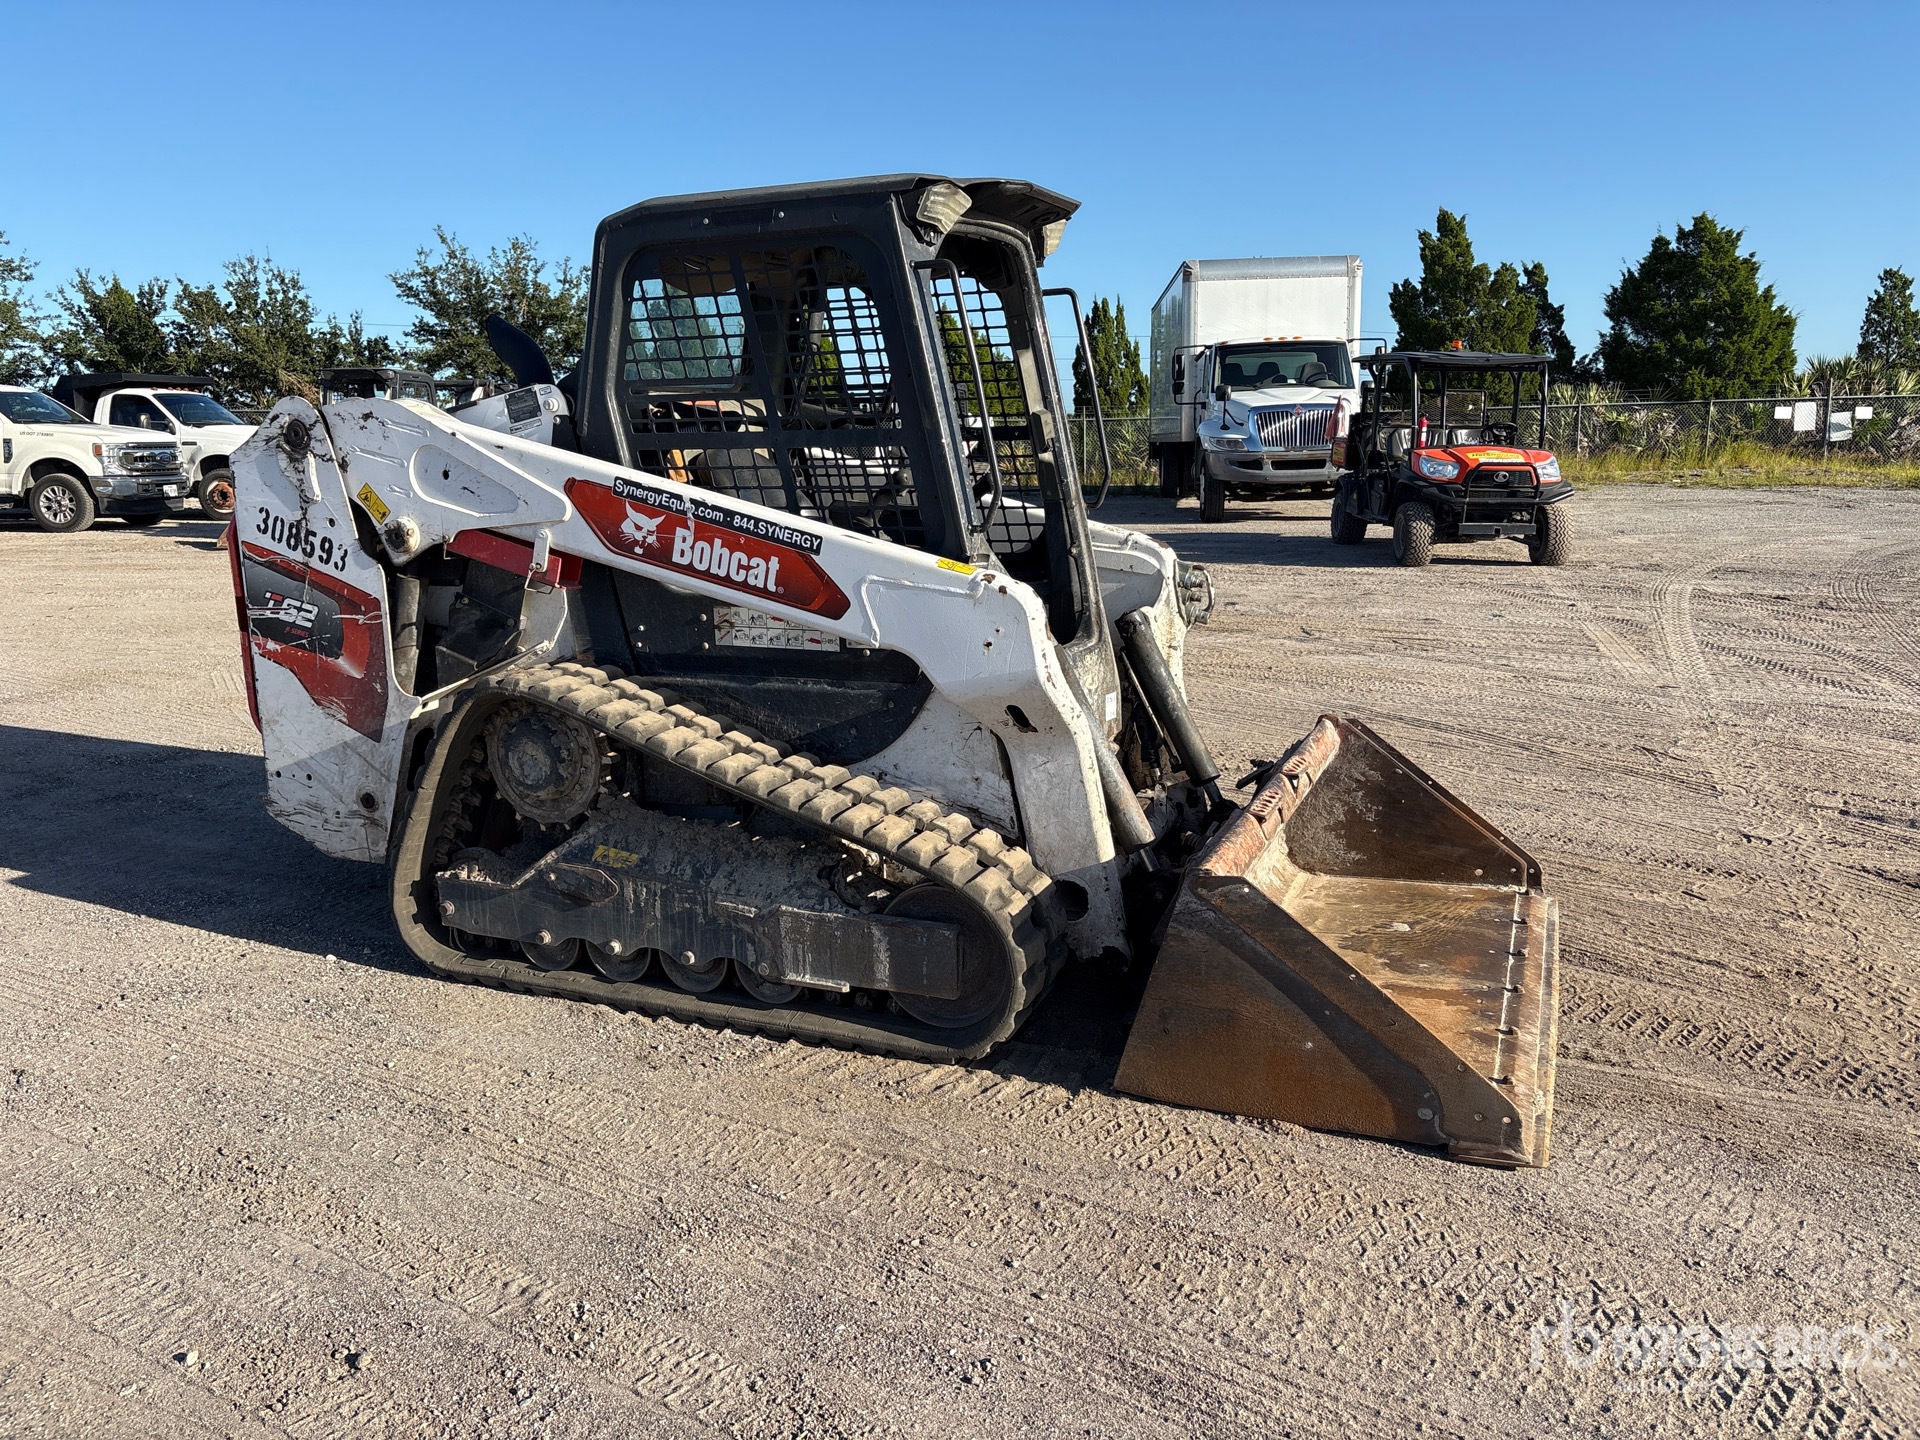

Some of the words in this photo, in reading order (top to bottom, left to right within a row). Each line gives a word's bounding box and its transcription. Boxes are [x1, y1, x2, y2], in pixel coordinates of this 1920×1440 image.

[256, 506, 348, 573] 308593
[614, 478, 724, 523] SynergyEquip.com
[732, 515, 822, 550] 844.SYNERGY
[671, 527, 781, 593] Bobcat
